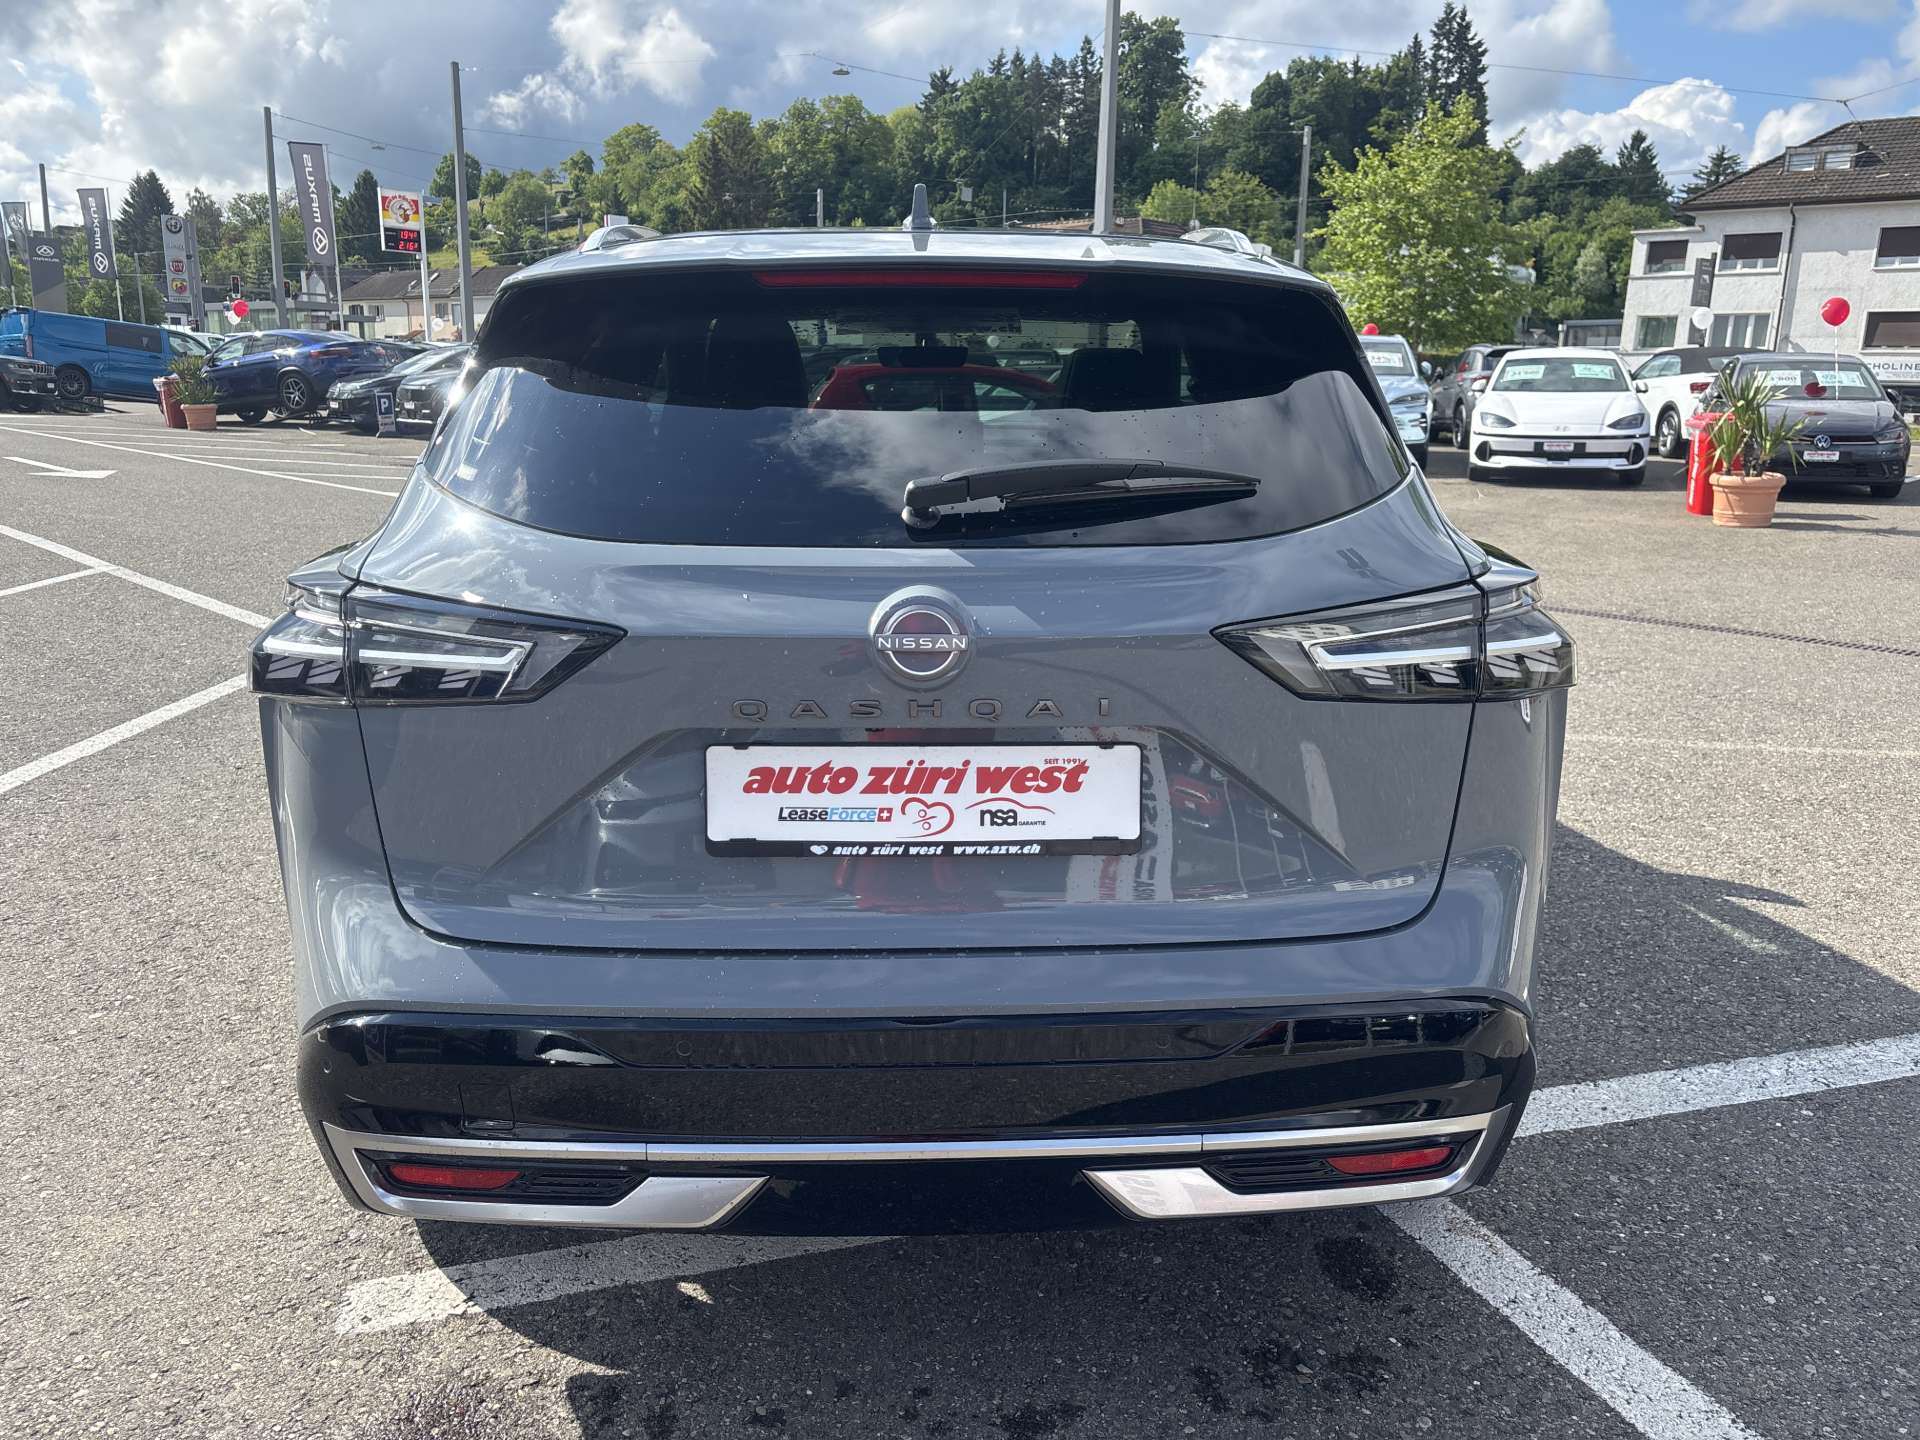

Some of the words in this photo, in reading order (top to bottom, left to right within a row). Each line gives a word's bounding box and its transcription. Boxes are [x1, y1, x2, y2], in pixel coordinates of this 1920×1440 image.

[1868, 362, 1920, 370] HOLINE
[380, 398, 389, 413] P
[877, 637, 967, 649] NISSAN
[731, 697, 1112, 722] QASHQAI
[1062, 758, 1082, 766] 1991
[742, 760, 859, 795] auto
[859, 759, 971, 795] züri
[975, 759, 1090, 795] west
[777, 806, 878, 821] LeaseForce
[979, 808, 1018, 827] nsa
[832, 844, 868, 856] auto
[870, 843, 906, 856] züri
[908, 844, 944, 856] west
[953, 843, 1042, 856] www.azw.ch
